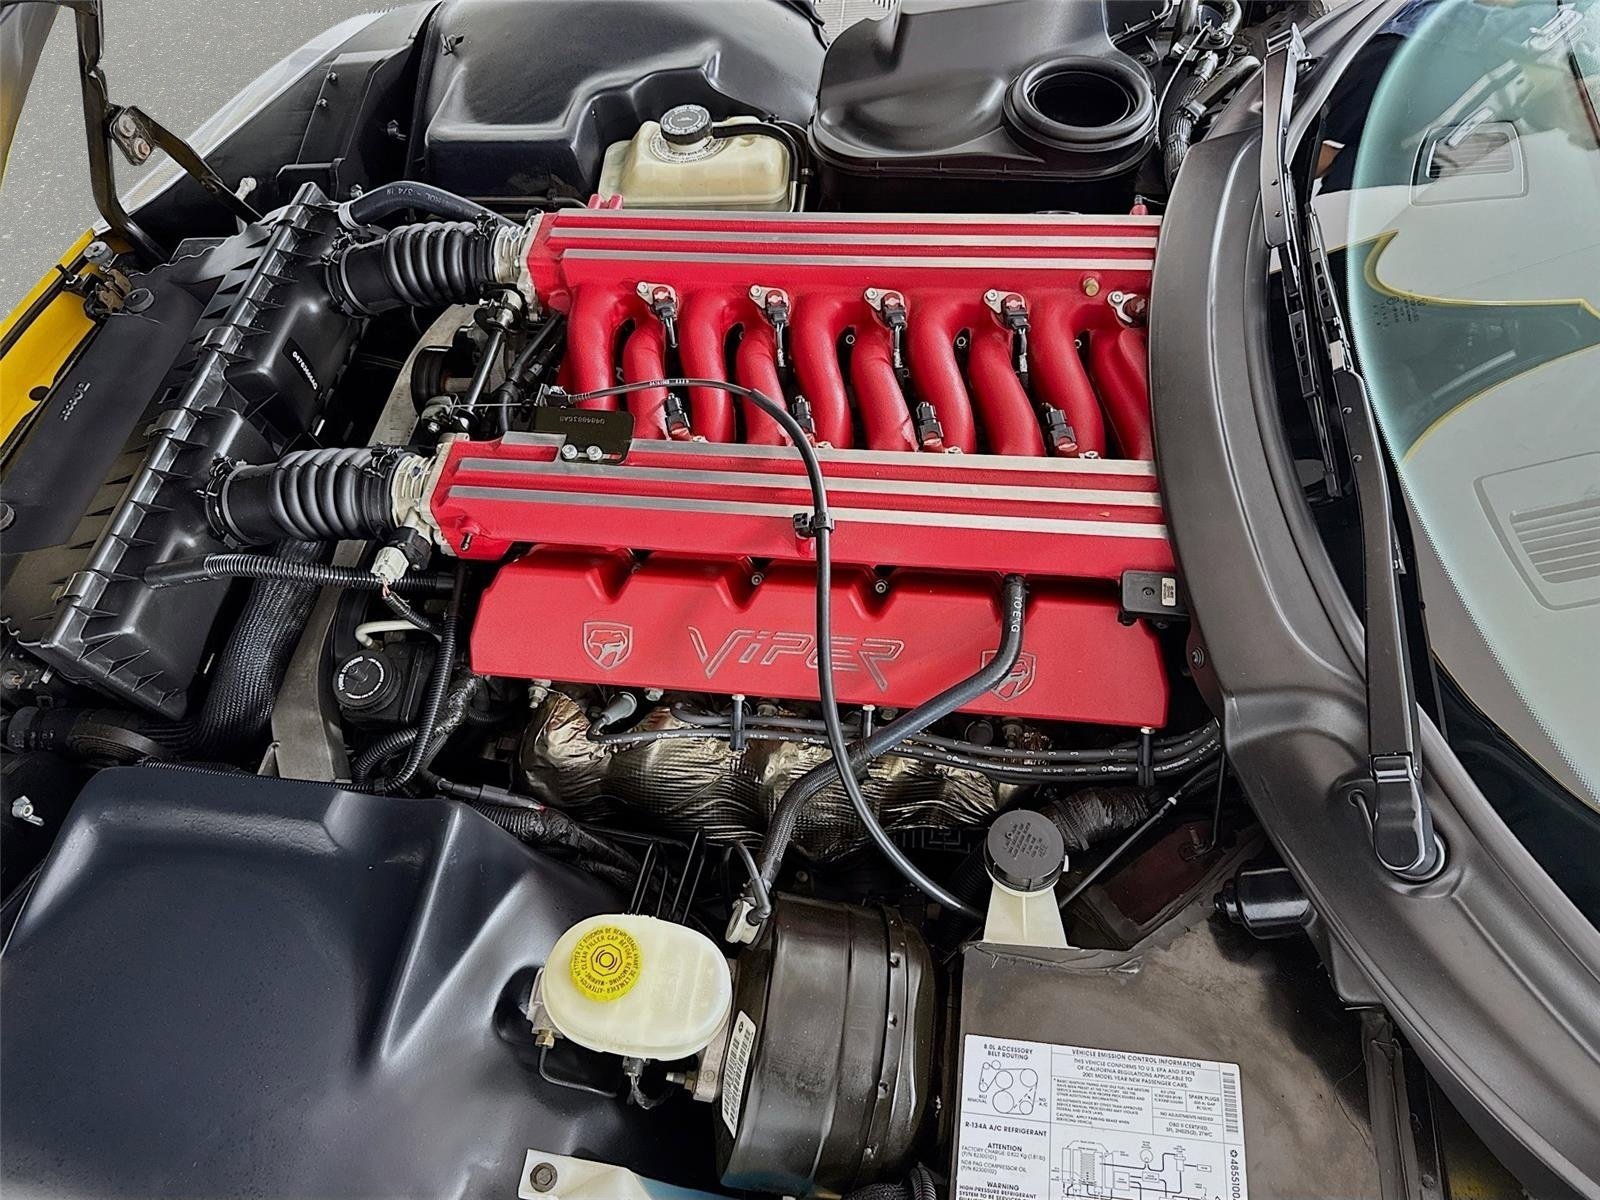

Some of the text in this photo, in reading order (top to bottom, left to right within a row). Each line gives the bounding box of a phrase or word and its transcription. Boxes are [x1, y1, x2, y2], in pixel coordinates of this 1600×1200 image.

[1014, 596, 1022, 608] TO
[998, 1045, 1033, 1054] ACCESSORY
[1098, 1052, 1126, 1060] EMISSION
[1128, 1055, 1157, 1063] CONTROL
[1159, 1058, 1201, 1068] INFORMATION
[1107, 1062, 1137, 1070] CONFORMS
[1085, 1066, 1116, 1074] CALIFORNIA
[1118, 1069, 1152, 1078] REGULATIONS
[1154, 1073, 1184, 1082] APPLICABLE
[1142, 1078, 1171, 1087] PASSENGER
[965, 1122, 987, 1130] R-134A
[1004, 1126, 1046, 1137] REFRIGERANT
[987, 1142, 1022, 1152] ATTENTION
[1230, 1159, 1241, 1200] 4855100
[987, 1181, 1019, 1191] WARNING
[1001, 1190, 1036, 1199] REFRIGERANT
